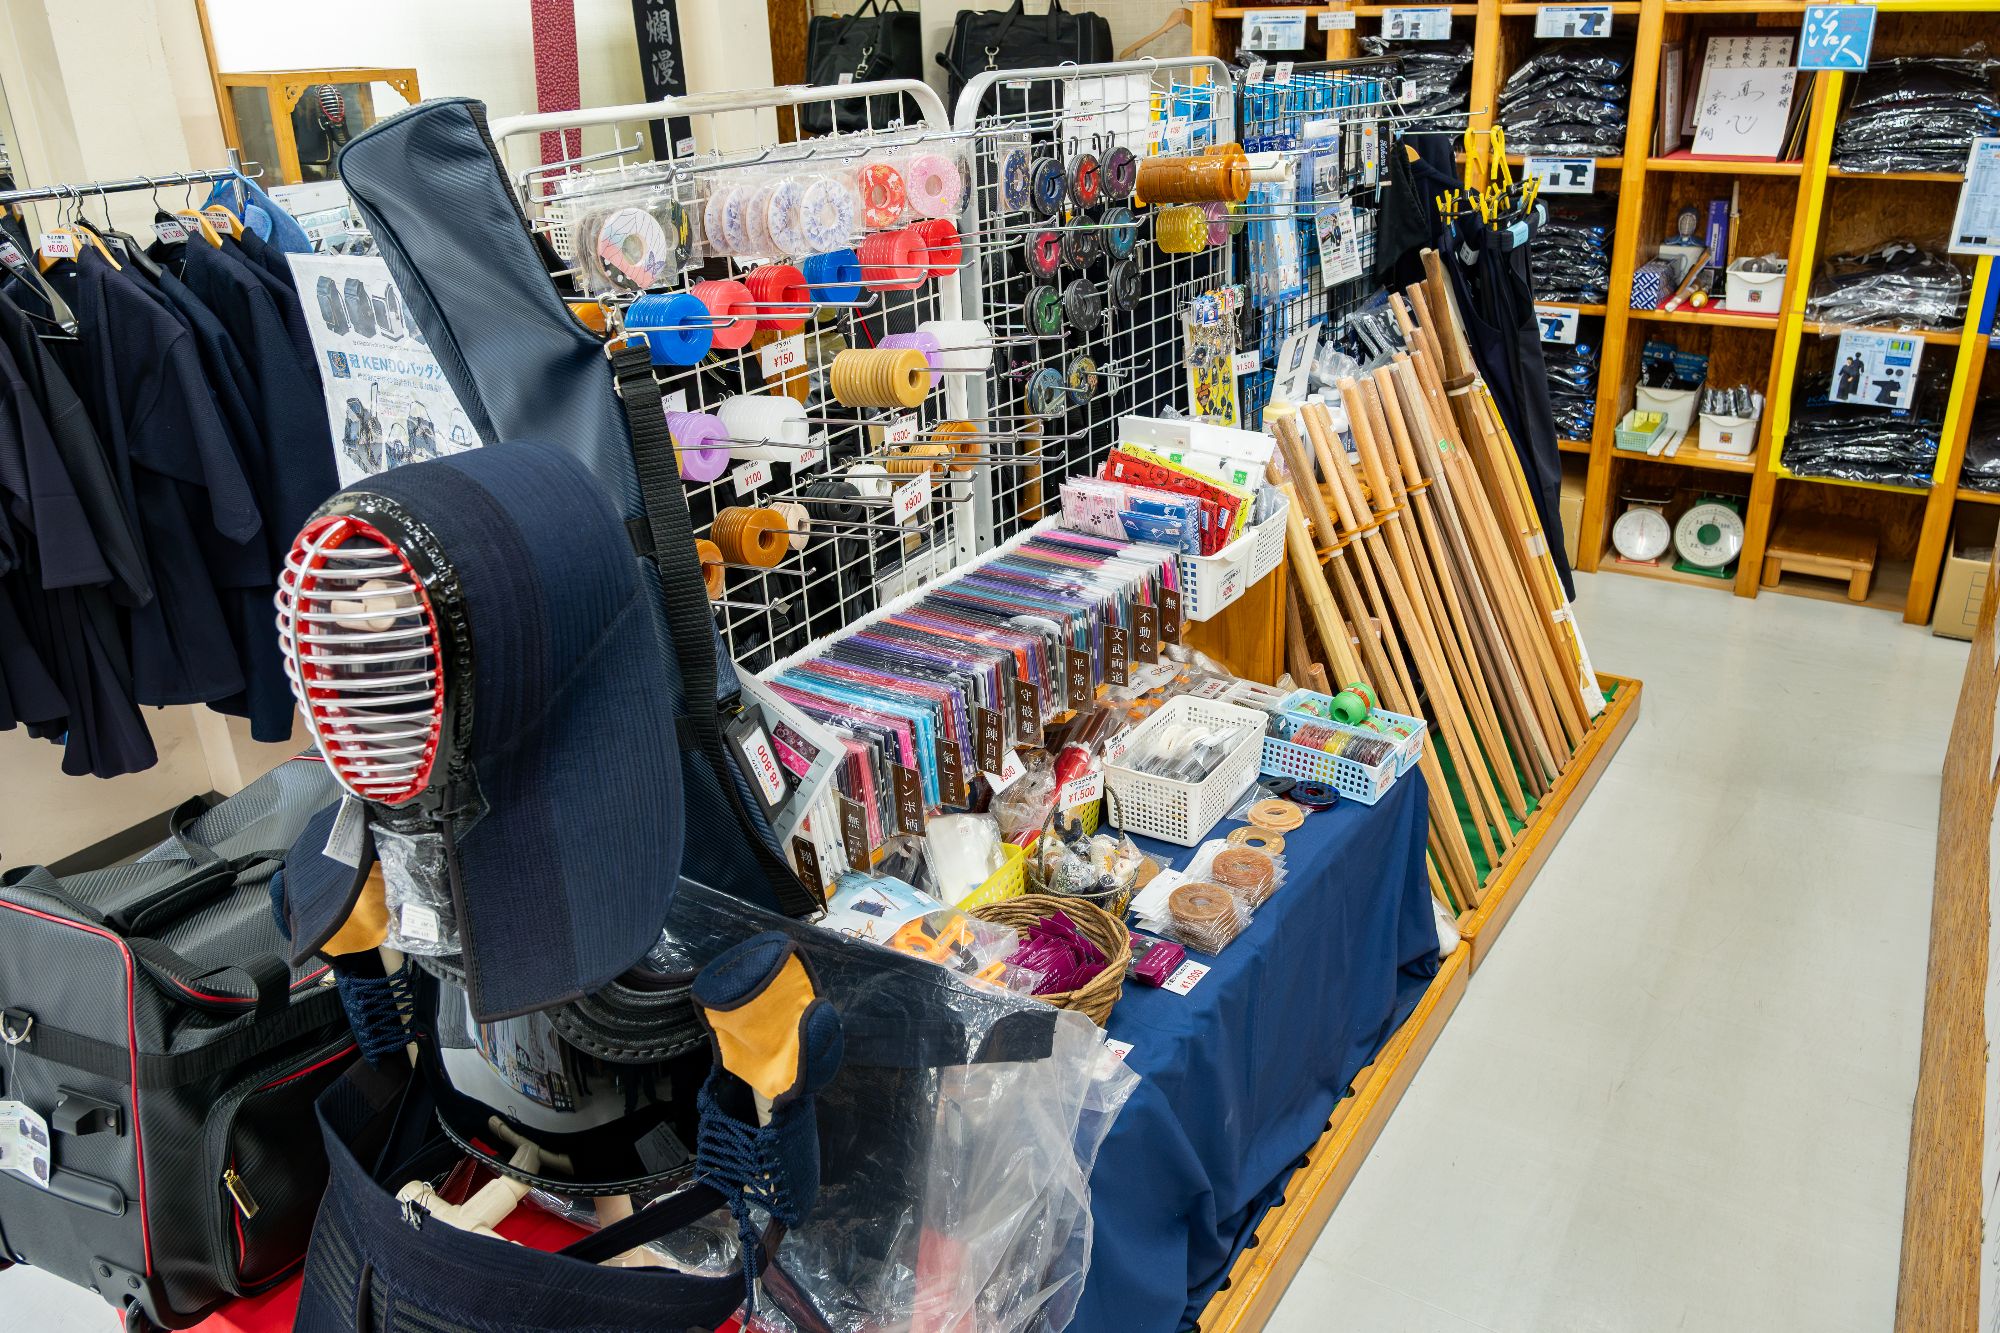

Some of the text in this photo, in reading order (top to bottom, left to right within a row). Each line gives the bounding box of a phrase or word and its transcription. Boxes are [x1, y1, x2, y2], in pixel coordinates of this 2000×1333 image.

[645, 0, 680, 86] 爛漫
[773, 351, 794, 367] ¥150
[744, 470, 762, 487] ¥100
[1138, 611, 1151, 653] 不動心
[1165, 596, 1176, 634] 無心
[1111, 628, 1124, 684] 文武両道
[1073, 658, 1086, 701] 平常心
[1020, 688, 1034, 735] 守破離
[902, 769, 918, 832] トンボ柄
[1068, 785, 1096, 804] ¥1,500
